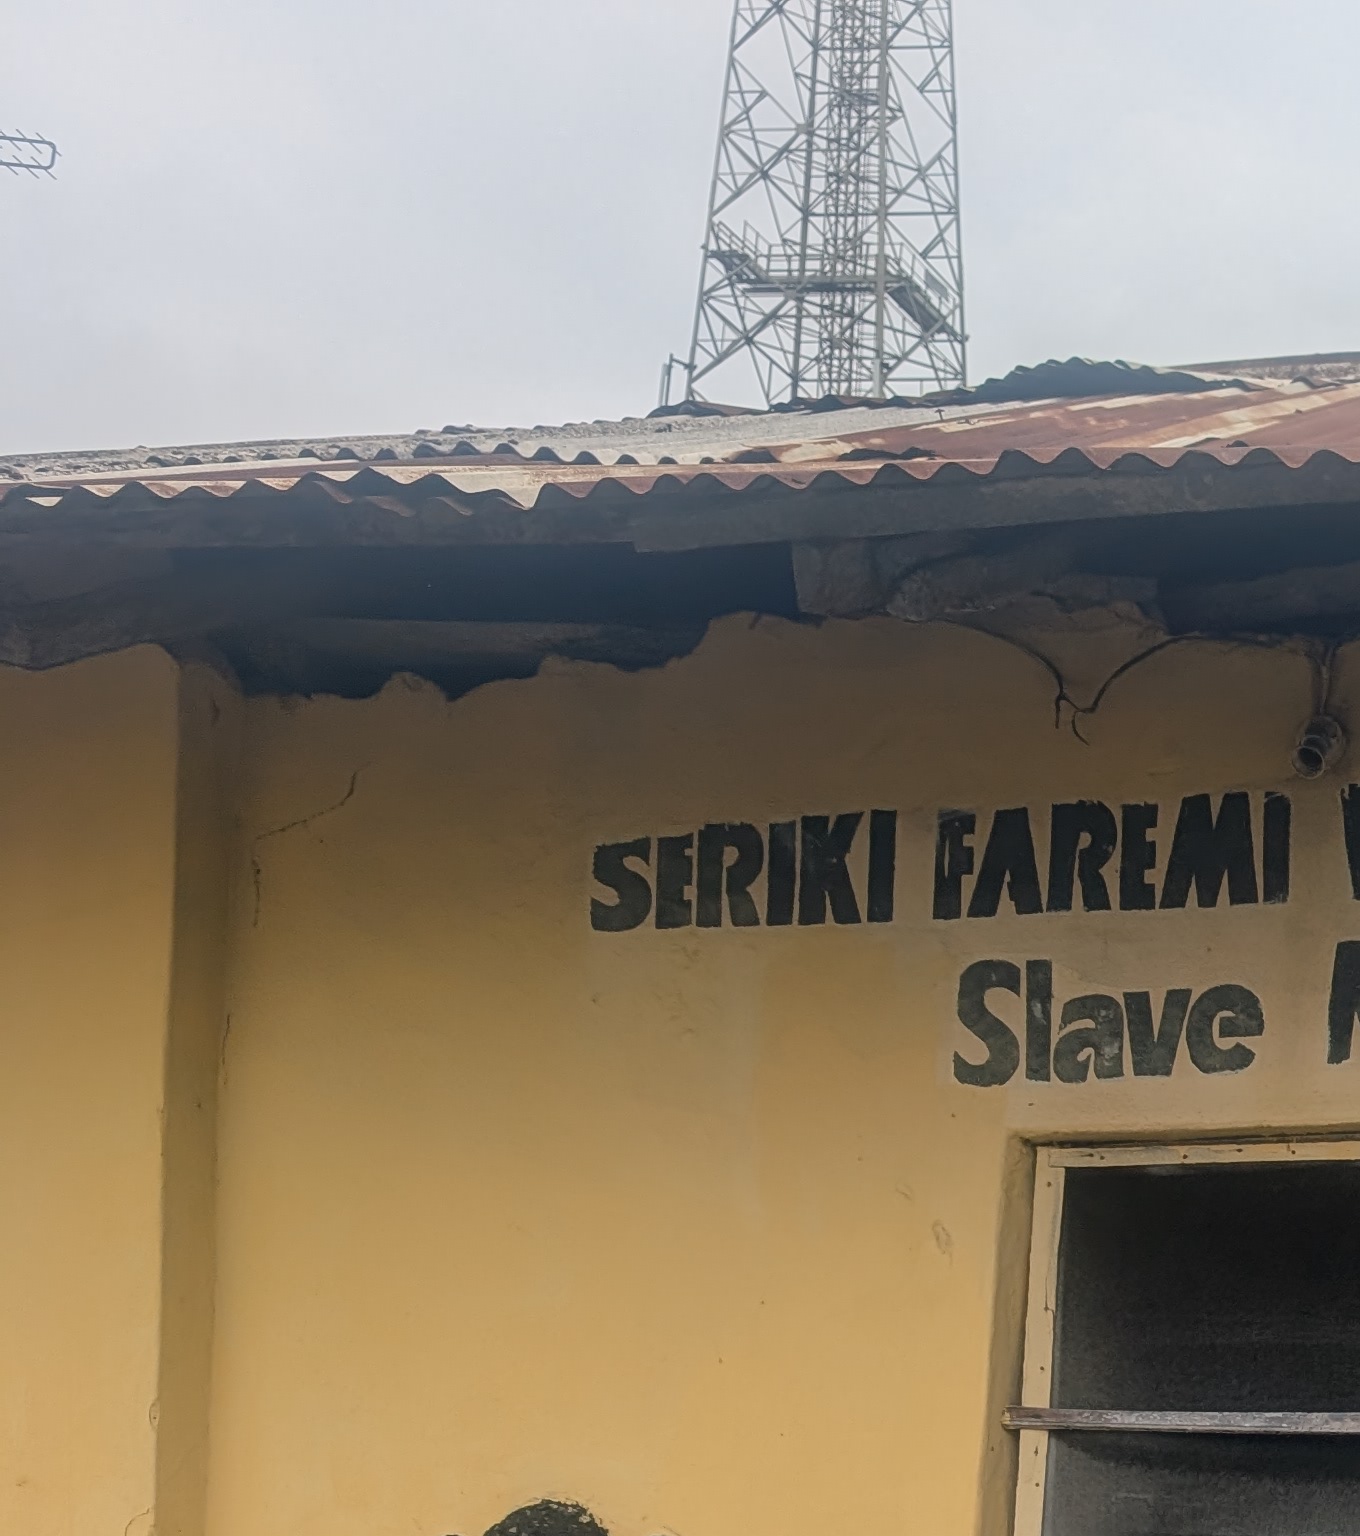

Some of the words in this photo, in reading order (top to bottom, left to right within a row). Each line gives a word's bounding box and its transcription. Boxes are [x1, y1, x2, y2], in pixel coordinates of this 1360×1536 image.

[590, 808, 898, 933] SERIKI
[932, 789, 1292, 921] FAREMI
[952, 958, 1266, 1088] Slave
